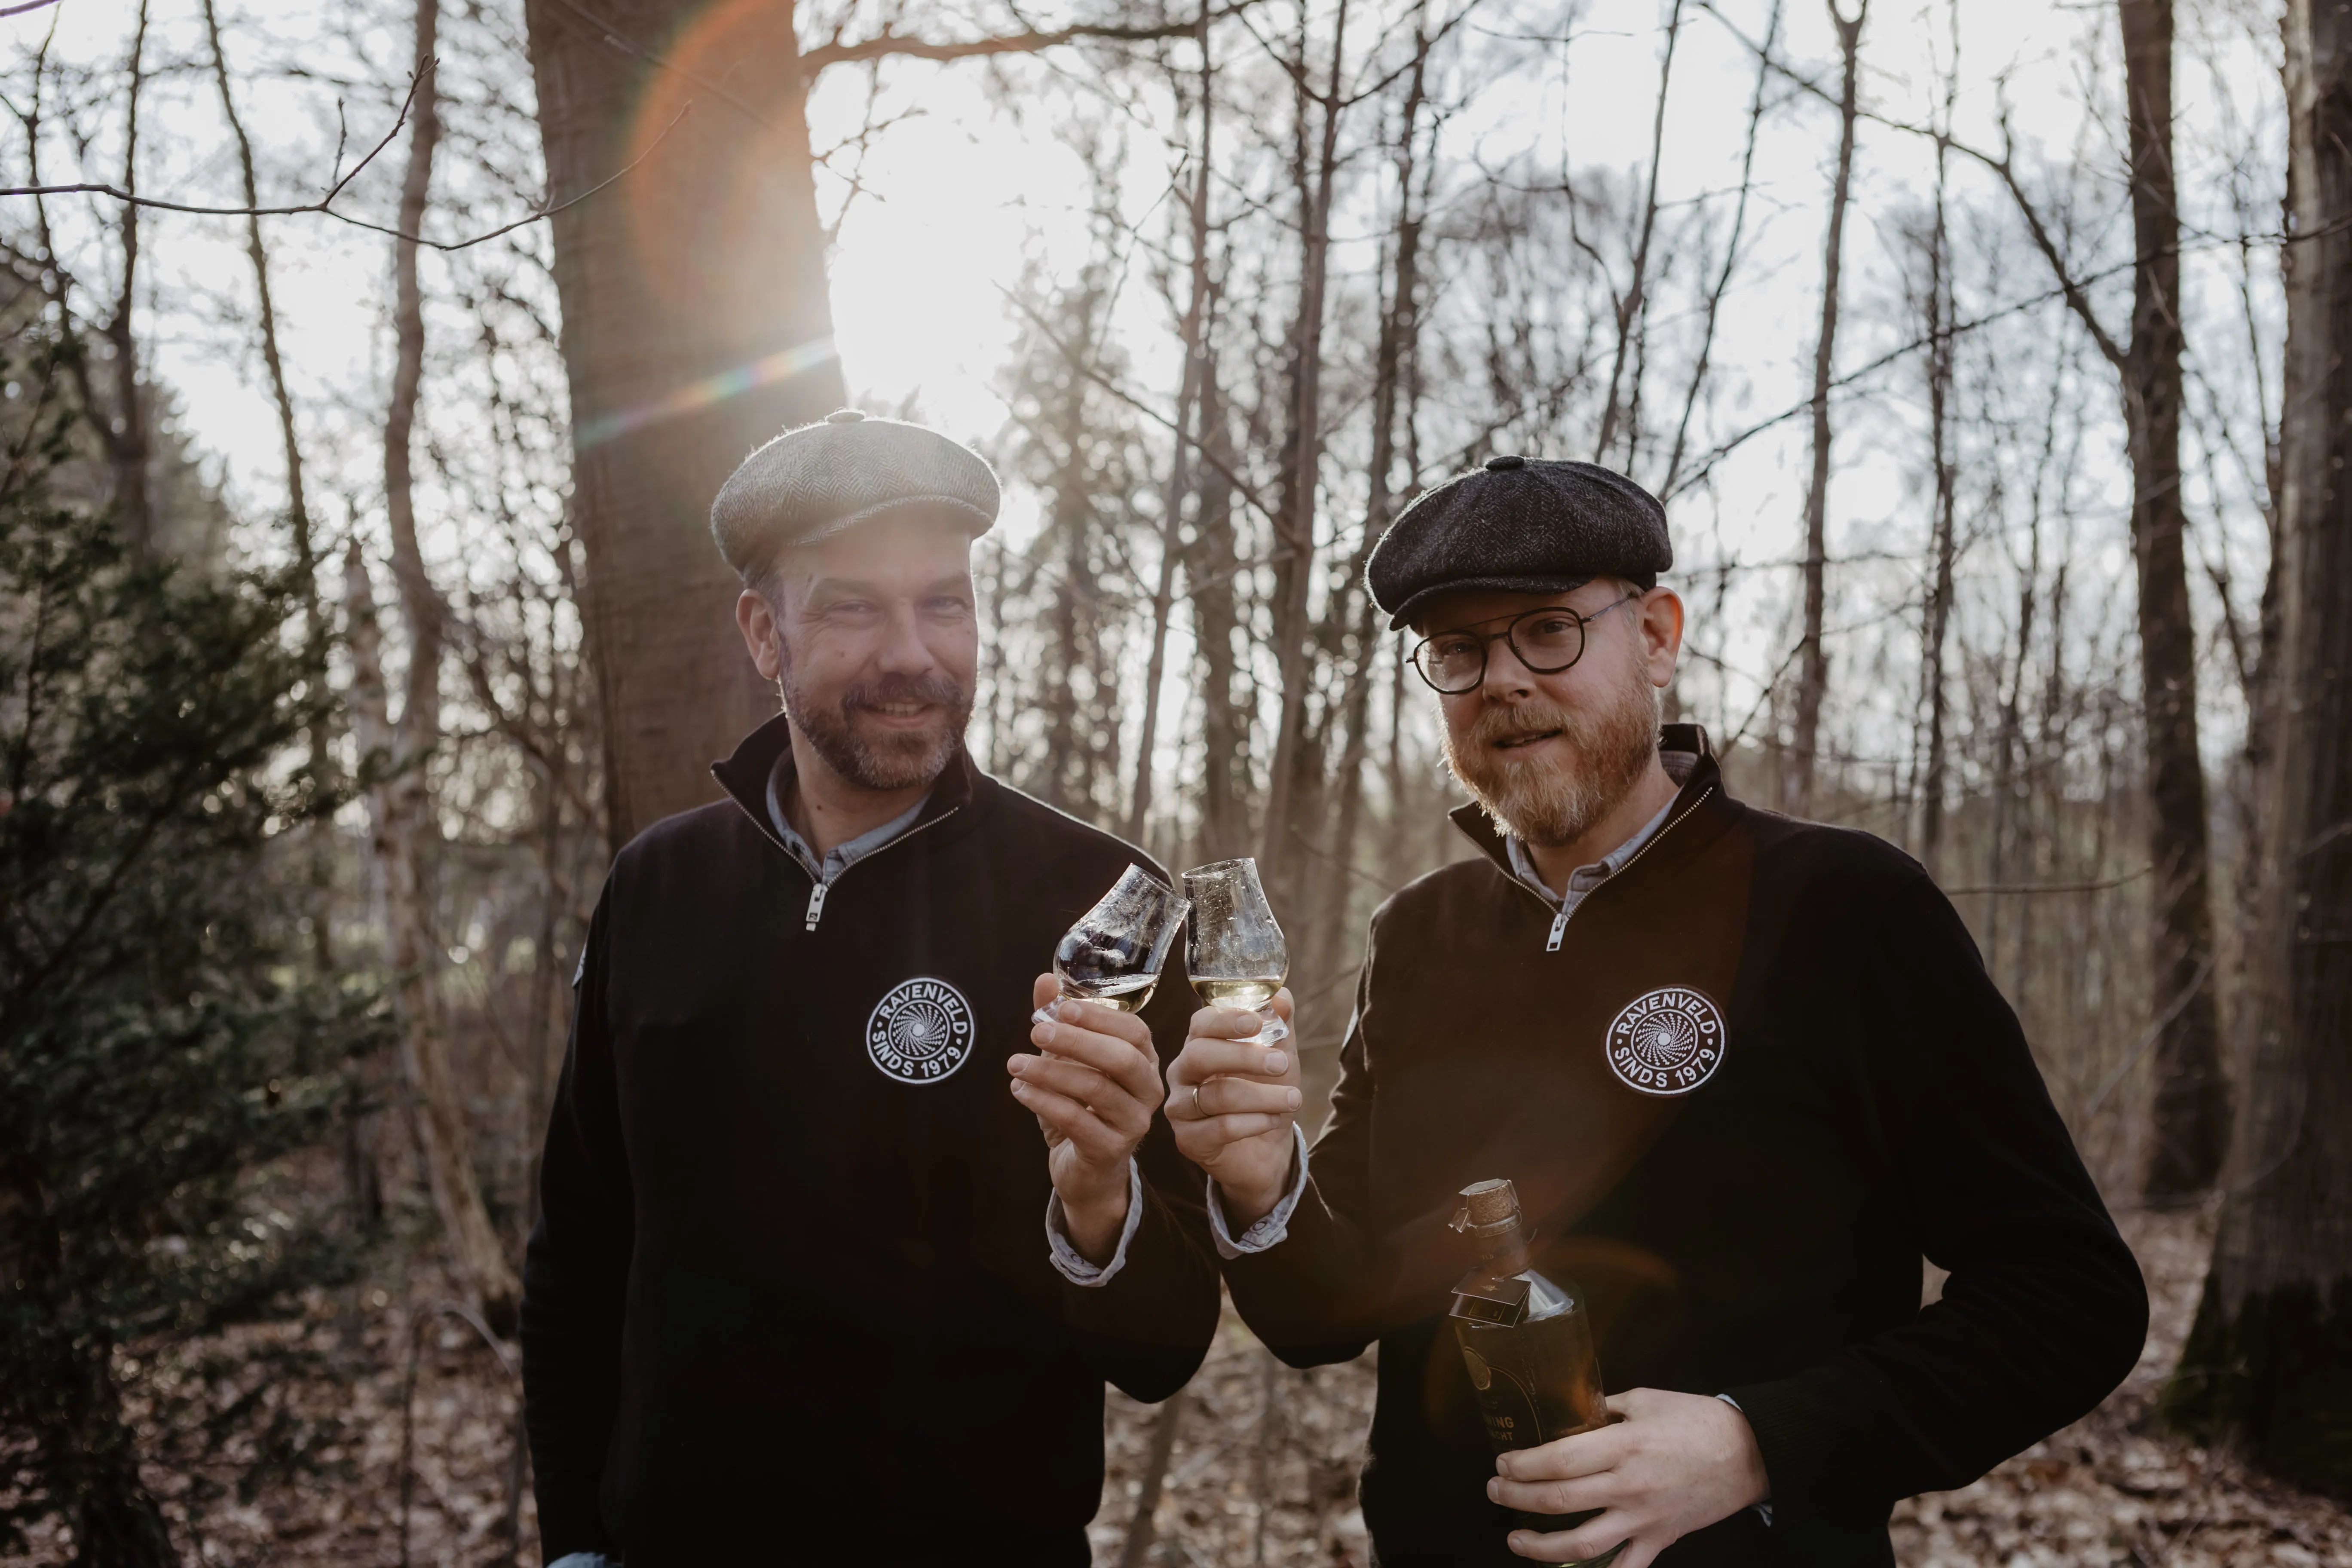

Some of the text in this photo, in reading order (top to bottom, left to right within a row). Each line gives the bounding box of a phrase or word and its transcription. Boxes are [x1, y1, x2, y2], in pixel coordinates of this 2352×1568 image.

[879, 983, 968, 1034] RAVENVELD
[1616, 993, 1716, 1034] RAVENVELD
[872, 1030, 962, 1078] SINDS 1979
[1614, 1047, 1715, 1087] SINDS 1979
